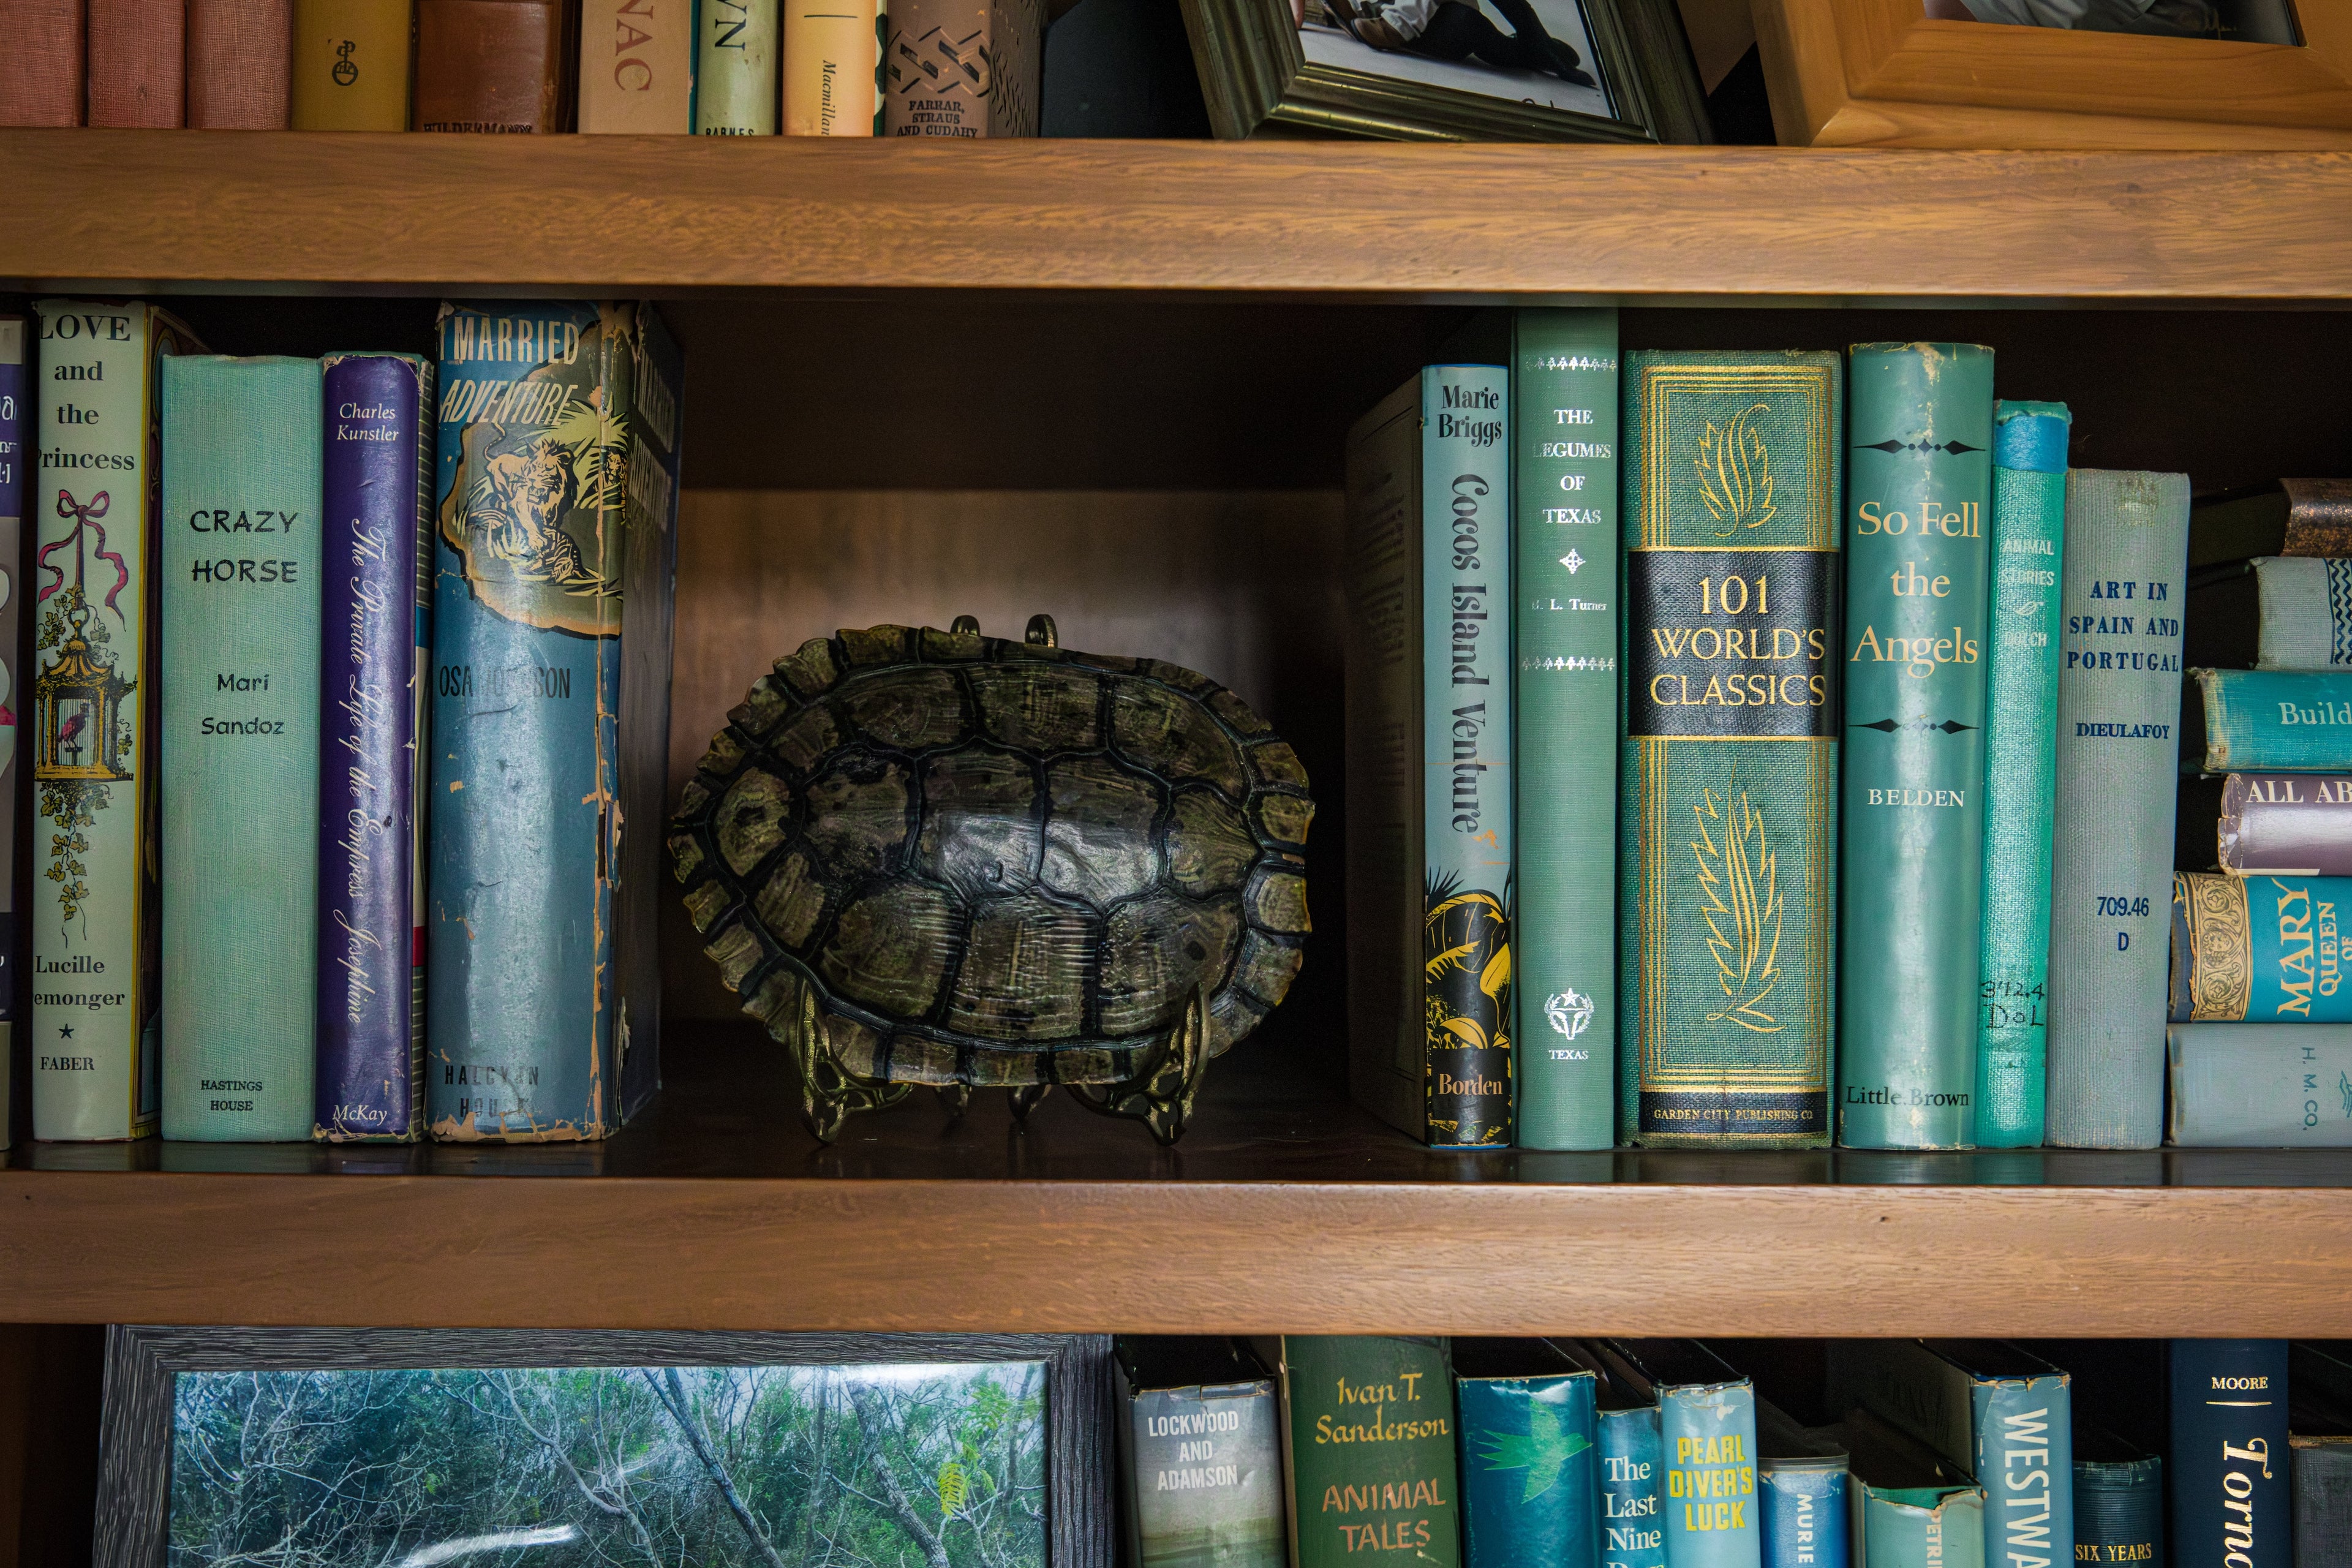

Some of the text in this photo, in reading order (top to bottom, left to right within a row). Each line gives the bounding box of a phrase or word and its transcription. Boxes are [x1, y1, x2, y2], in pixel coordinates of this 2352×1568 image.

[821, 59, 836, 136] Macmillan
[908, 100, 964, 113] FARRAR,
[912, 113, 960, 124] STRAUS
[897, 126, 978, 138] AND CUDAHY
[39, 314, 130, 341] LOVE
[454, 316, 579, 364] MARRIED
[54, 361, 104, 381] and
[439, 379, 578, 426] ADVENTURE
[1441, 385, 1499, 410] Marie
[57, 404, 99, 424] the
[339, 402, 396, 420] Charles
[1554, 409, 1593, 424] THE
[337, 424, 399, 441] Kunstler
[1437, 413, 1502, 447] Briggs
[38, 447, 135, 470] rincess
[1560, 475, 1585, 491] OF
[190, 510, 298, 533] CRAZY
[1542, 508, 1602, 524] TEXAS
[1858, 502, 1981, 538] So Fell
[352, 518, 386, 567] The
[2002, 538, 2054, 556] ANIMAL
[192, 559, 298, 583] HORSE
[1890, 561, 1951, 598] the
[2002, 570, 2054, 586] STORIES
[1698, 575, 1769, 614] 101
[2090, 581, 2168, 601] ART IN
[1550, 598, 1563, 610] L.
[2069, 616, 2178, 636] SPAIN AND
[1451, 474, 1490, 834] Cocos Island Venture
[1651, 627, 1825, 660] WORLD'S
[1850, 625, 1978, 679] Angels
[2067, 651, 2178, 673] PORTUGAL
[217, 674, 270, 692] Mari
[439, 665, 473, 697] OSA
[1649, 674, 1826, 706] CLASSICS
[339, 674, 383, 728] Life
[2278, 702, 2352, 725] Build
[201, 717, 285, 736] Sandoz
[2076, 723, 2169, 739] DIEULAFOY
[338, 737, 377, 766] of
[349, 766, 377, 797] the
[2246, 780, 2304, 803] ALL
[1867, 789, 1965, 807] BELDEN
[338, 809, 383, 897] Empress
[2097, 896, 2149, 917] 709.46
[2118, 932, 2129, 951] D
[2271, 878, 2315, 1017] MARY
[2317, 901, 2342, 996] QUEEN
[35, 956, 105, 973] Lucille
[333, 909, 382, 1023] Josephine
[32, 992, 125, 1011] emonger
[40, 1057, 95, 1071] FABER
[1549, 1049, 1588, 1060] TEXAS
[201, 1080, 263, 1091] HASTINGS
[1438, 1073, 1502, 1095] Borden
[210, 1101, 253, 1111] HOUSE
[1909, 1088, 1969, 1106] Brown
[333, 1104, 387, 1126] McKay
[1654, 1109, 1700, 1120] GARDEN
[1703, 1109, 1731, 1120] CITY
[1736, 1109, 1798, 1121] PUBLISHING
[1337, 1373, 1423, 1405] Ivan T.
[2211, 1377, 2268, 1390] MOORE
[1148, 1411, 1238, 1437] LOCKWOOD
[1315, 1404, 1449, 1444] Sanderson
[1179, 1441, 1213, 1462] AND
[1677, 1434, 1746, 1465] PEARL
[1158, 1465, 1238, 1491] ADAMSON
[1605, 1456, 1651, 1482] The
[1669, 1466, 1753, 1498] DIVER'S
[1322, 1477, 1446, 1513] ANIMAL
[1604, 1493, 1657, 1518] Last
[1685, 1501, 1746, 1531] LUCK
[1339, 1519, 1431, 1553] TALES
[1605, 1528, 1661, 1551] Nine
[1796, 1494, 1814, 1564] MURIE
[2075, 1543, 2152, 1561] SIX YEARS
